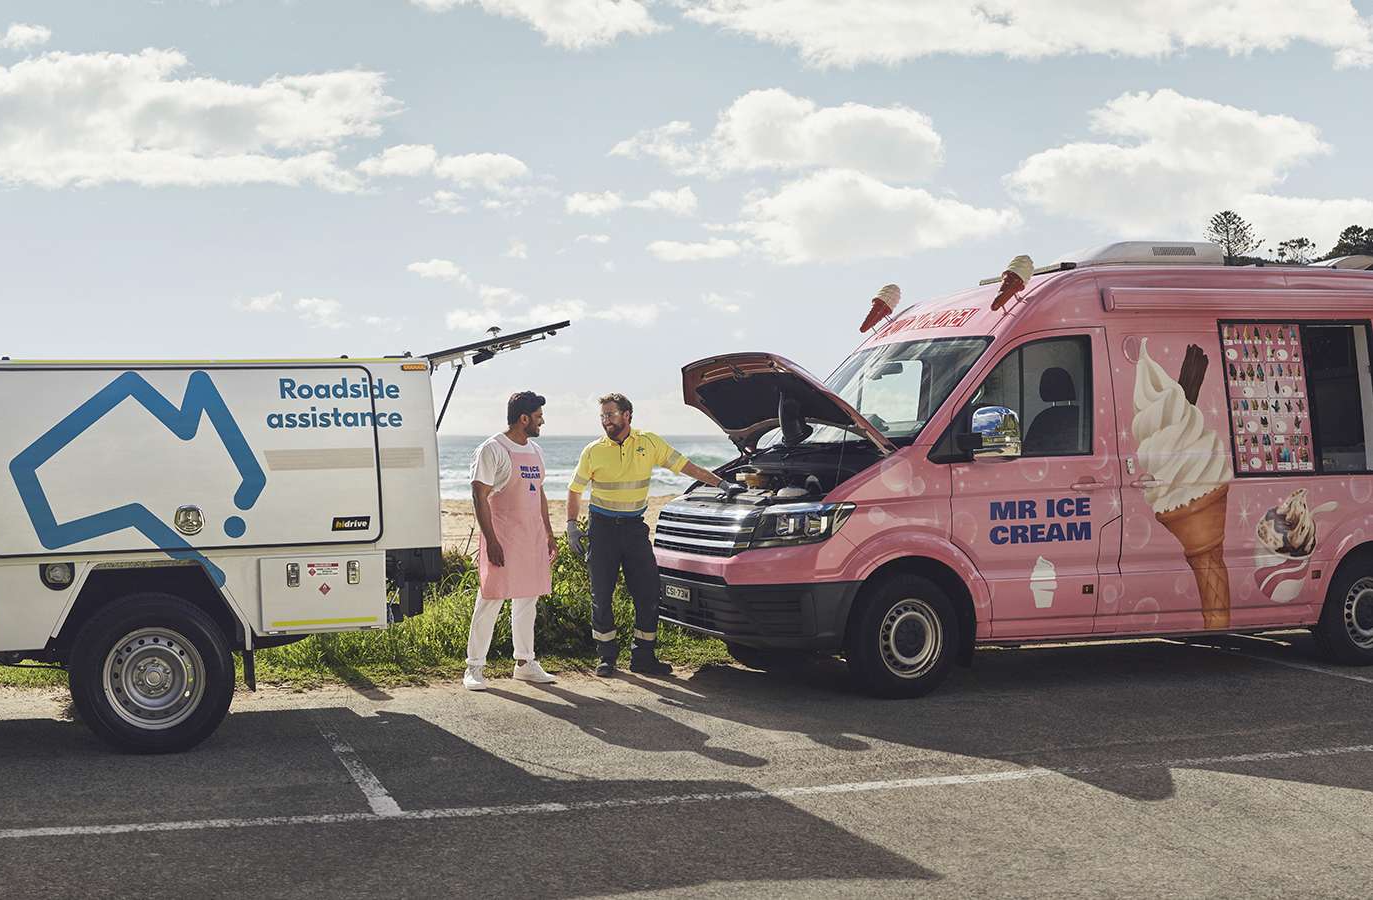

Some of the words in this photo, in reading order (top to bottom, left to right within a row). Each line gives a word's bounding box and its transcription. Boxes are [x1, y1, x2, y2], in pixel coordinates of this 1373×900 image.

[279, 377, 400, 399] Roadside
[266, 406, 403, 429] assistance
[990, 500, 1037, 520] MR
[1046, 497, 1091, 518] ICE
[335, 519, 368, 529] hidrive
[989, 521, 1092, 545] CREAM
